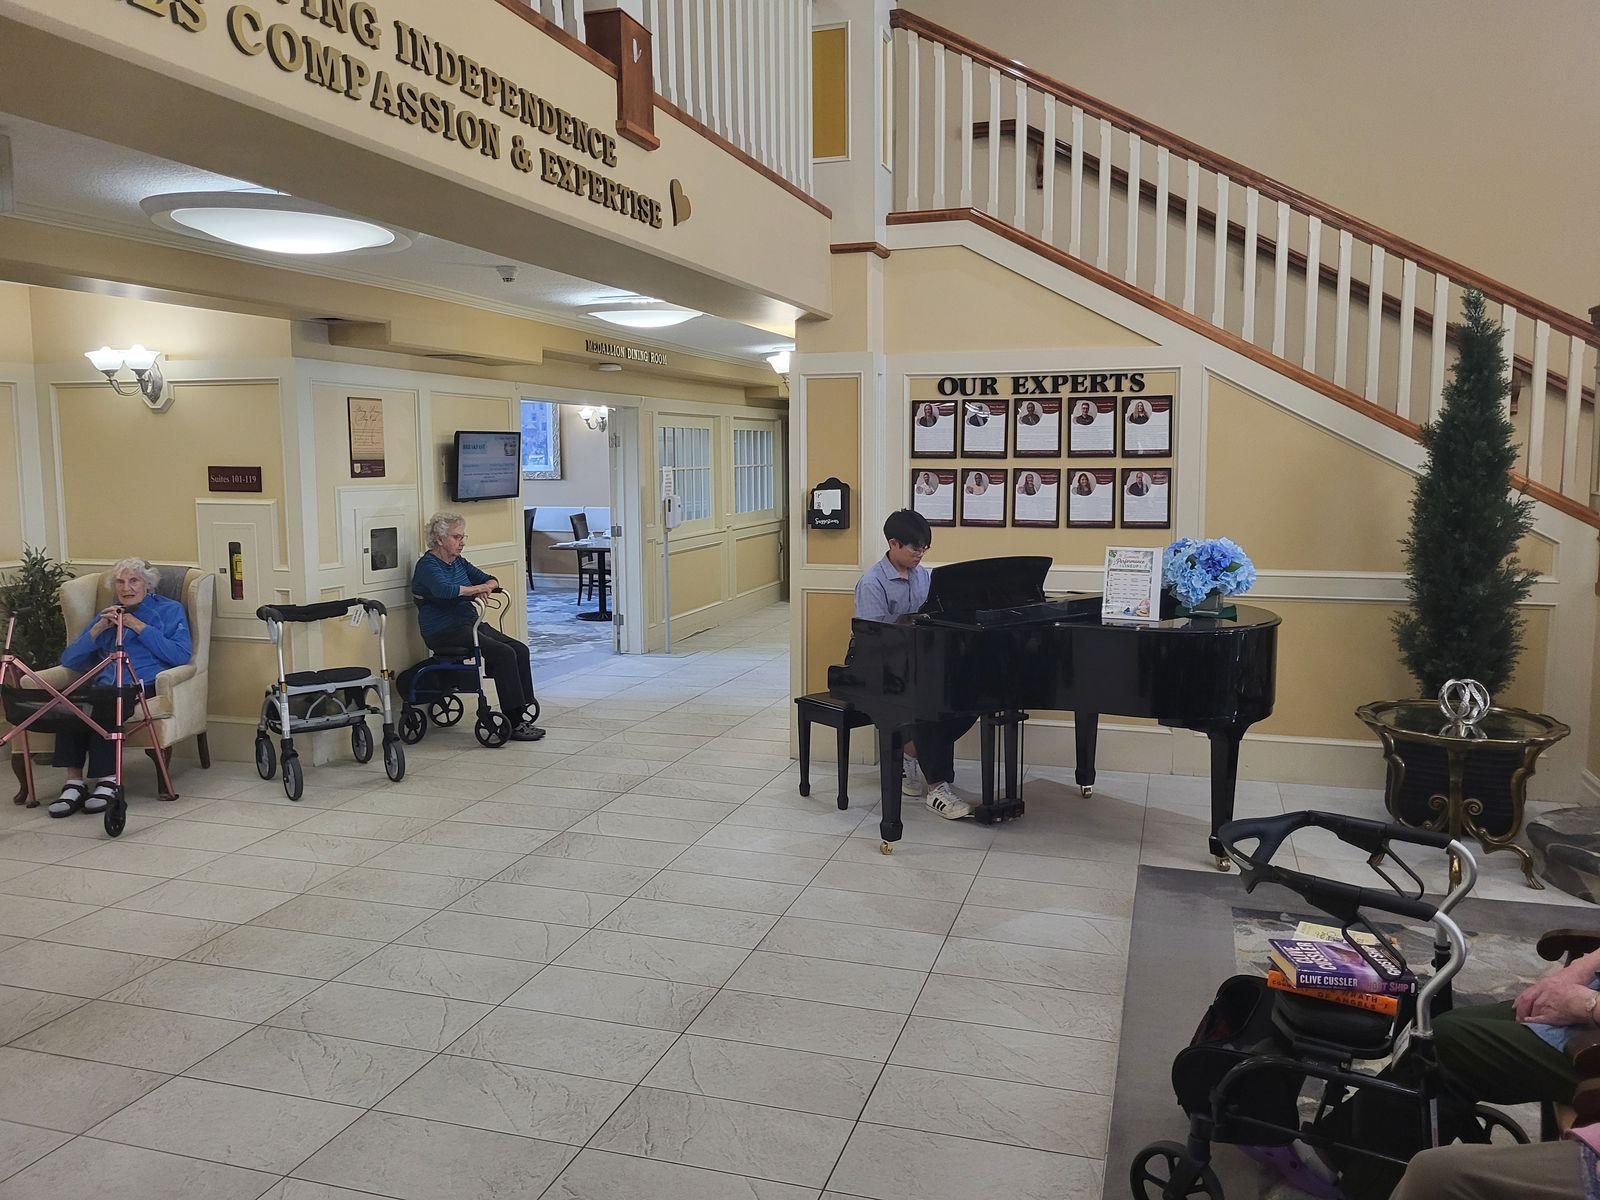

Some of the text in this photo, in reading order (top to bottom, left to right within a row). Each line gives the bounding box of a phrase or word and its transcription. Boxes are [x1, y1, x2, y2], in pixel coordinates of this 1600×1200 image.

[394, 20, 617, 167] INDEPENDENCE
[227, 5, 501, 159] COMPASSION
[511, 135, 533, 172] &
[540, 148, 662, 229] EXPERTISE
[626, 347, 649, 362] DINING
[650, 351, 667, 365] ROOM
[938, 373, 1145, 396] OUR EXPERTS
[210, 475, 257, 484] Suites 101-119
[1300, 974, 1322, 985] CLIVE
[1323, 976, 1358, 988] CUSSLER
[1389, 981, 1409, 993] SHIP
